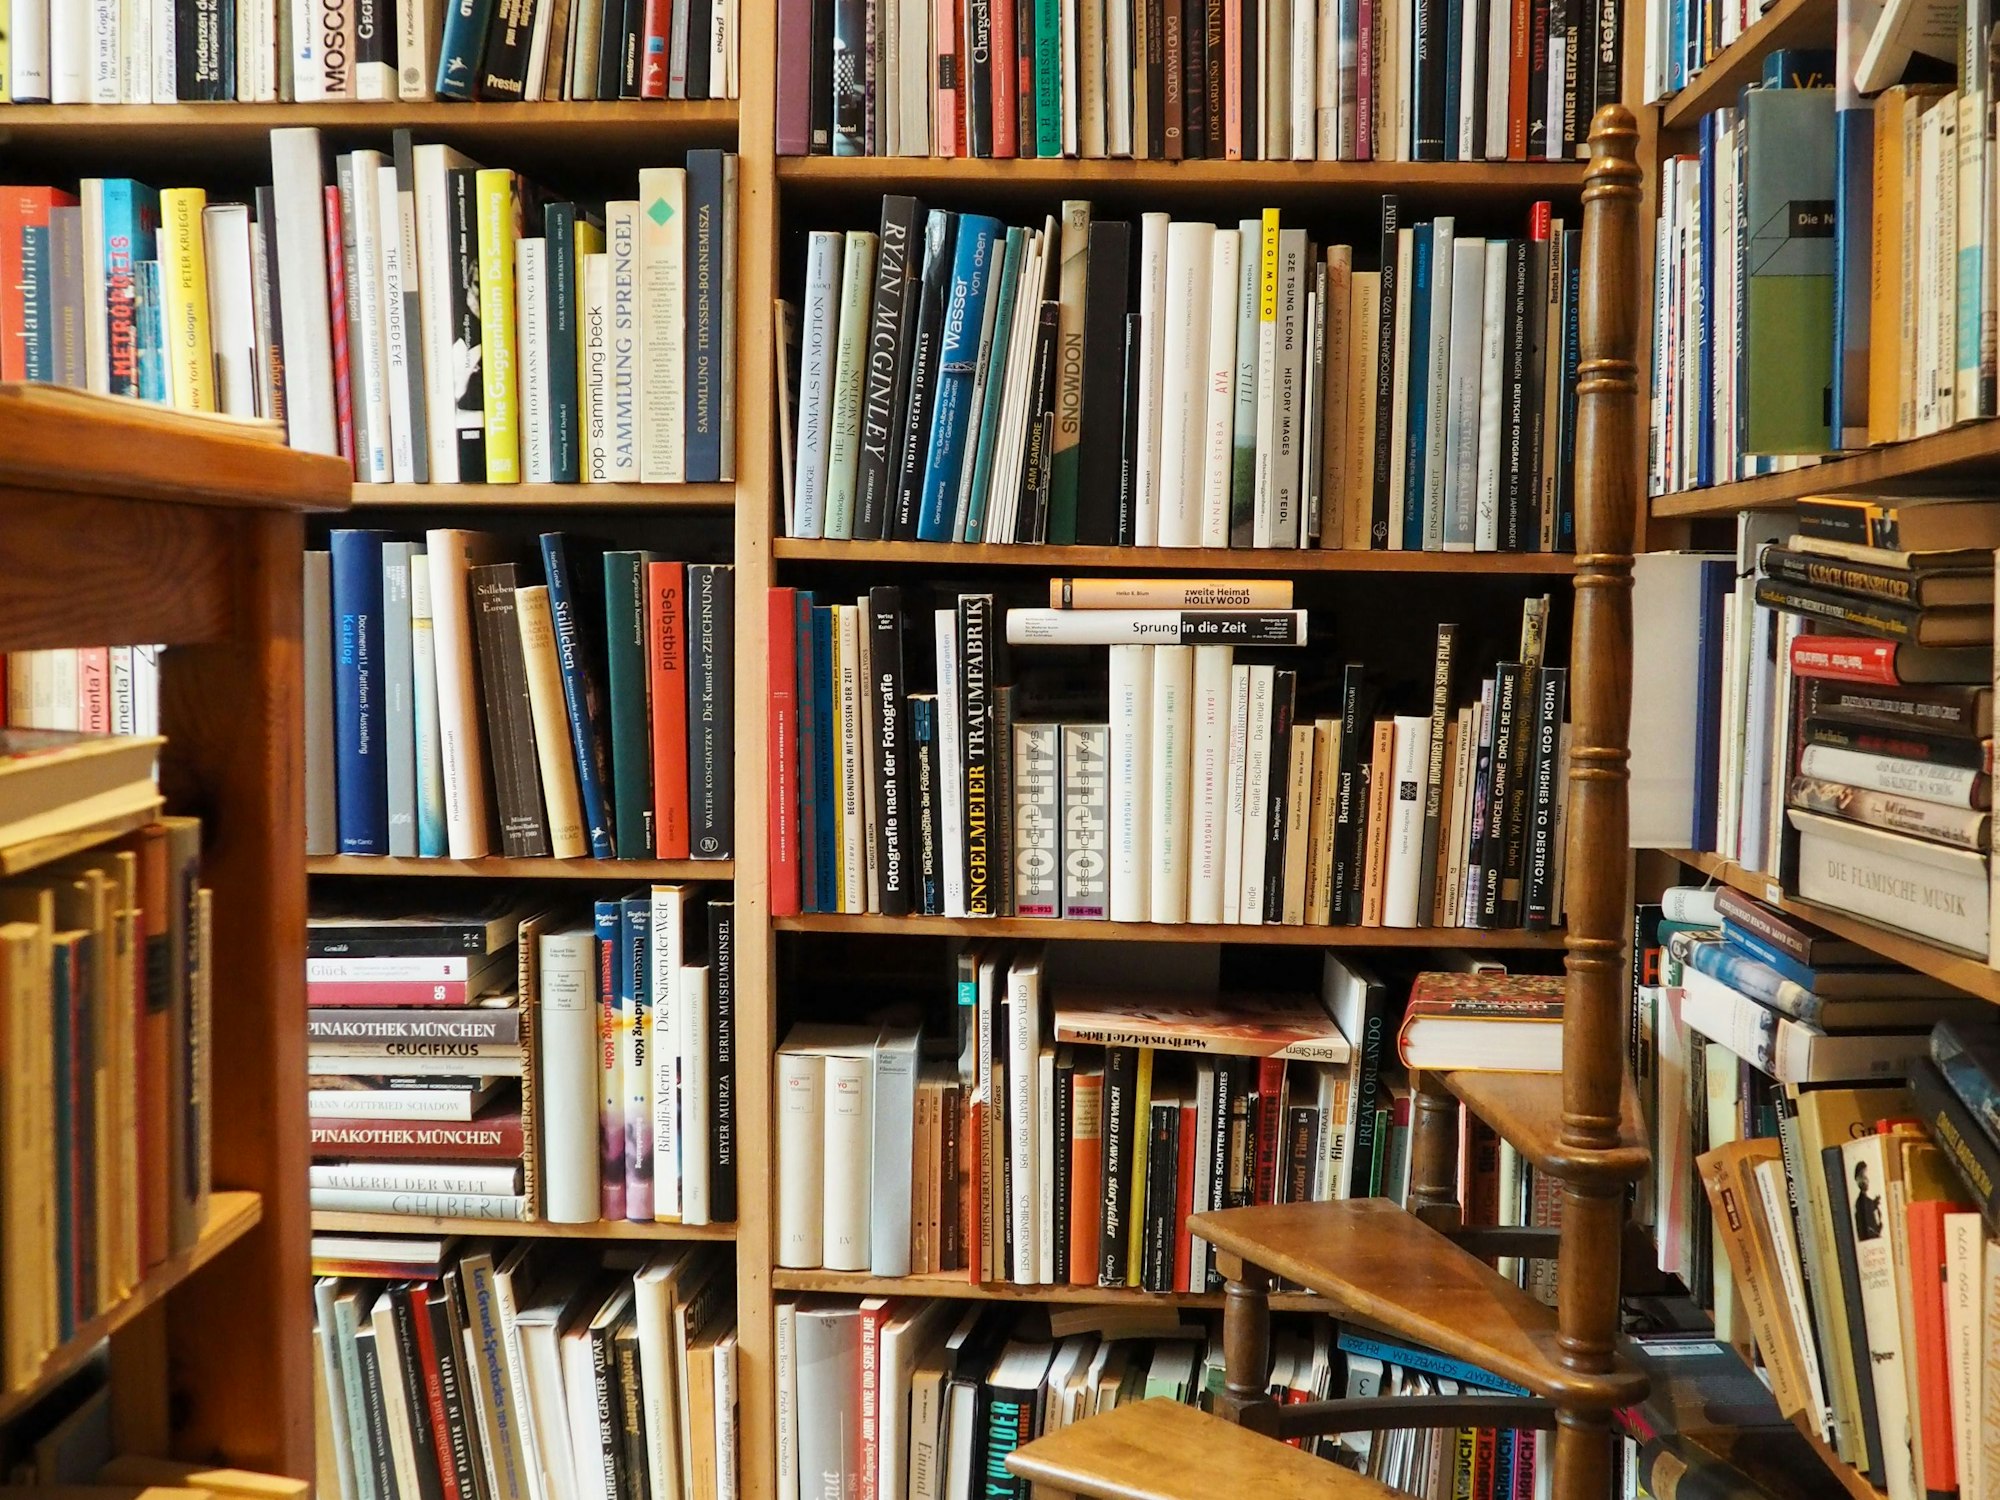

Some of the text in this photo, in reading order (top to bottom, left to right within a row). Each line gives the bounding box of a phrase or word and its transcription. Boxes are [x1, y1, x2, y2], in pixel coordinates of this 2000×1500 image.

[195, 12, 209, 81] Tendenzen
[626, 33, 636, 86] westermann
[1039, 37, 1051, 108] EMERSON
[1166, 15, 1178, 103] DAVID HAMILTON
[1564, 26, 1578, 141] RAINER LEITZGEN
[1208, 60, 1220, 141] FLOR GARDUÑO
[176, 199, 192, 288] PETER KRUEGER
[1384, 204, 1396, 235] KHM
[1798, 214, 1818, 226] Die
[970, 231, 988, 296] von oben
[1264, 227, 1275, 317] SUGIMOTO
[1285, 253, 1296, 351] SZE TSUNG LEONG
[110, 236, 133, 376] METROPOLIS
[387, 247, 403, 367] THE EXPANDED EYE
[488, 193, 507, 434] The Guggenheim Die Sammlung
[587, 306, 603, 348] beck
[613, 214, 633, 469] SAMMLUNG SPRENGEL
[697, 204, 710, 433] SAMMLUNG THYSSEN-BORNEMISZA
[864, 220, 907, 462] RYAN MCGINLEY
[946, 275, 968, 350] Wasser
[1513, 244, 1526, 380] VON KÖRPERN UND ANDEREN DINGEN
[525, 245, 541, 476] EMANUEL HOFFMANN STIFTUNG BASEL
[806, 296, 824, 452] ANIMALS IN MOTION
[1062, 333, 1082, 434] SNOWDON
[1214, 370, 1229, 394] AYA
[1240, 362, 1253, 406] STILL
[1380, 321, 1392, 396] PHOTOGRAPHIEN
[906, 331, 930, 473] INDIAN OCEAN JOURNALS
[1282, 368, 1292, 456] HISTORY IMAGES
[1512, 383, 1522, 424] DEUTSCHE
[1511, 425, 1521, 473] FOTOGRAFIE
[1511, 474, 1519, 484] IM
[901, 489, 911, 524] MAX PAM
[1212, 470, 1222, 535] ANNELIES
[1279, 489, 1289, 525] STEIDL
[1508, 497, 1518, 548] JAHRHUNDERT
[660, 587, 677, 671] Selbstbild
[1133, 621, 1247, 636] Sprung in die Zeit
[1184, 596, 1251, 605] HOLLYWOOD
[1185, 588, 1250, 597] zweite Heimat
[341, 614, 354, 665] Katalog
[701, 574, 713, 721] Die Kunst der ZEICHNUNG
[966, 600, 985, 759] TRAUMFABRIK
[1428, 634, 1451, 784] HUMPHREY BOGART UND SEINE FILME
[1499, 712, 1510, 725] DE
[1500, 675, 1514, 710] DRAME
[1543, 681, 1556, 720] WHOM
[704, 726, 713, 829] WALTER KOSCHATZKY
[843, 667, 855, 815] BEGEGNUNGEN MIT GROSSEN DER ZEIT
[1496, 727, 1509, 759] DRÔLE
[1542, 726, 1554, 754] GOD
[880, 673, 901, 891] Fotografie nach der Fotografie
[1017, 729, 1054, 896] TOEPLITZ
[1030, 731, 1039, 895] GESCHICHTE DES FILMS
[1067, 730, 1104, 897] TOEPLITZ
[1080, 732, 1089, 897] GESCHICHTE DES FILMS
[1338, 772, 1352, 824] Bertolucci
[1491, 797, 1504, 838] MARCEL
[1537, 809, 1549, 826] TO
[1538, 759, 1552, 805] WISHES
[969, 765, 987, 913] ENGELMEIER
[1485, 869, 1497, 914] BALLAND
[1827, 859, 1848, 884] DIE
[1923, 884, 1967, 919] MUSIK
[633, 937, 646, 1067] Museum Ludwig Köln
[655, 902, 669, 1033] Die Naiven der Welt
[718, 920, 730, 1062] BERLIN MUSEUMSINSEL
[308, 1021, 496, 1038] PINAKOTHEK MÜNCHEN
[386, 1043, 479, 1056] CRUCIFIXUS
[1018, 984, 1028, 1051] GRETA GARBO
[1286, 1046, 1333, 1059] Bert Stern
[656, 1063, 671, 1153] Bihalji-Merin
[718, 1074, 730, 1165] MEYER/MURZA
[1358, 1016, 1383, 1147] FREAK ORLANDO
[311, 1128, 502, 1145] PINAKOTHEK MÜNCHEN
[1106, 1086, 1121, 1238] HOWARD HAWKS storyteller
[1215, 1071, 1229, 1175] SCHATTEN IM PARADIES
[590, 1338, 612, 1444] DER GENTER ALTAR
[861, 1316, 875, 1442] JOHN WAYNE UND SEINE FILME
